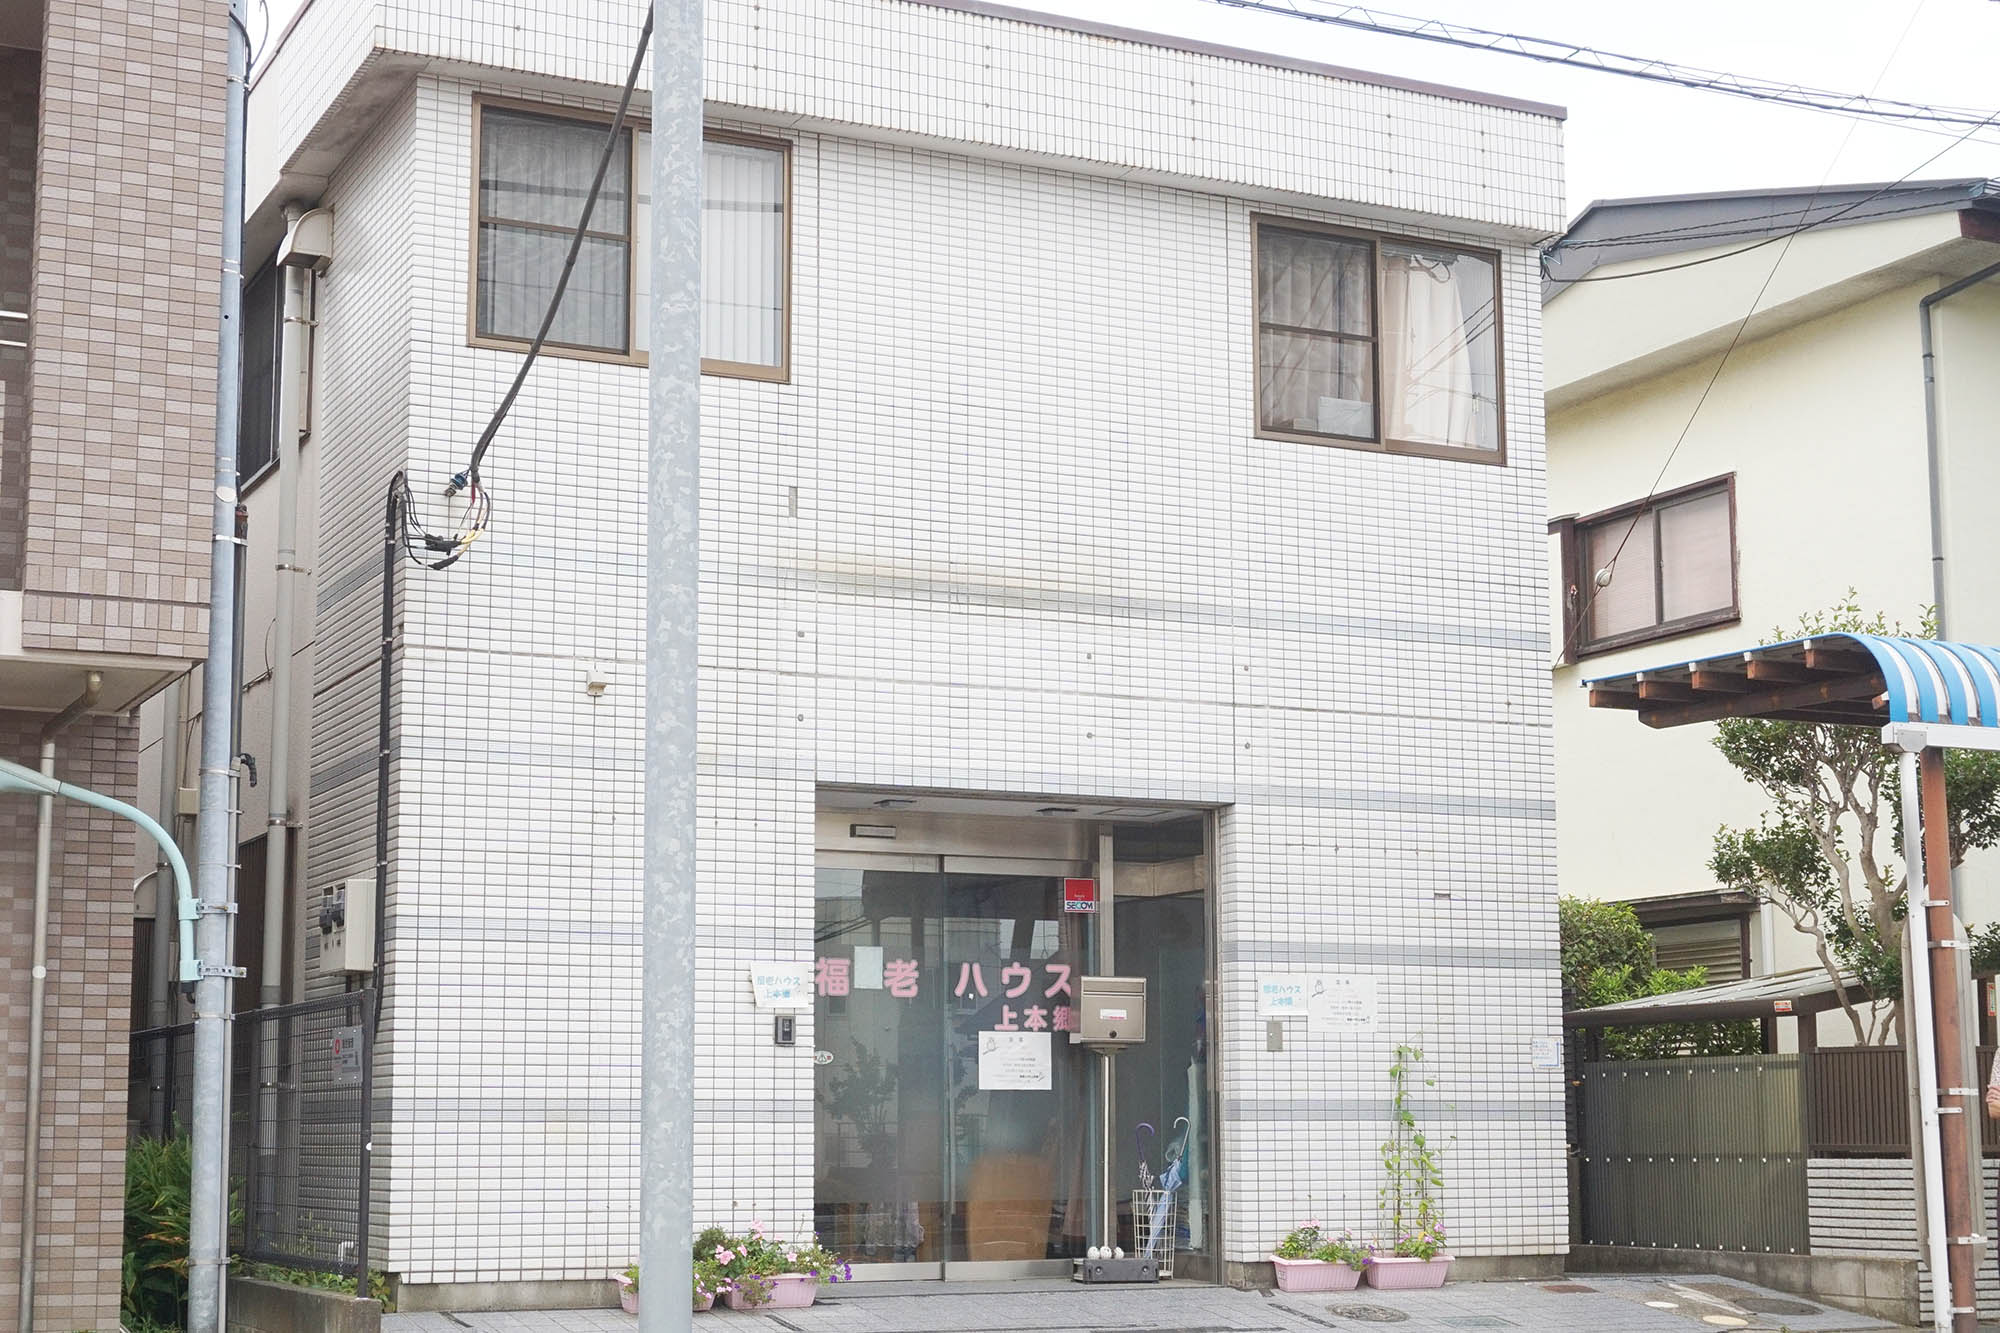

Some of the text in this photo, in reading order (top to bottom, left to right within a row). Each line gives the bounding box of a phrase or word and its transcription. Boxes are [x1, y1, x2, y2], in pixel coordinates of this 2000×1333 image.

[1066, 901, 1094, 910] SECOM
[1263, 984, 1301, 993] ハウス
